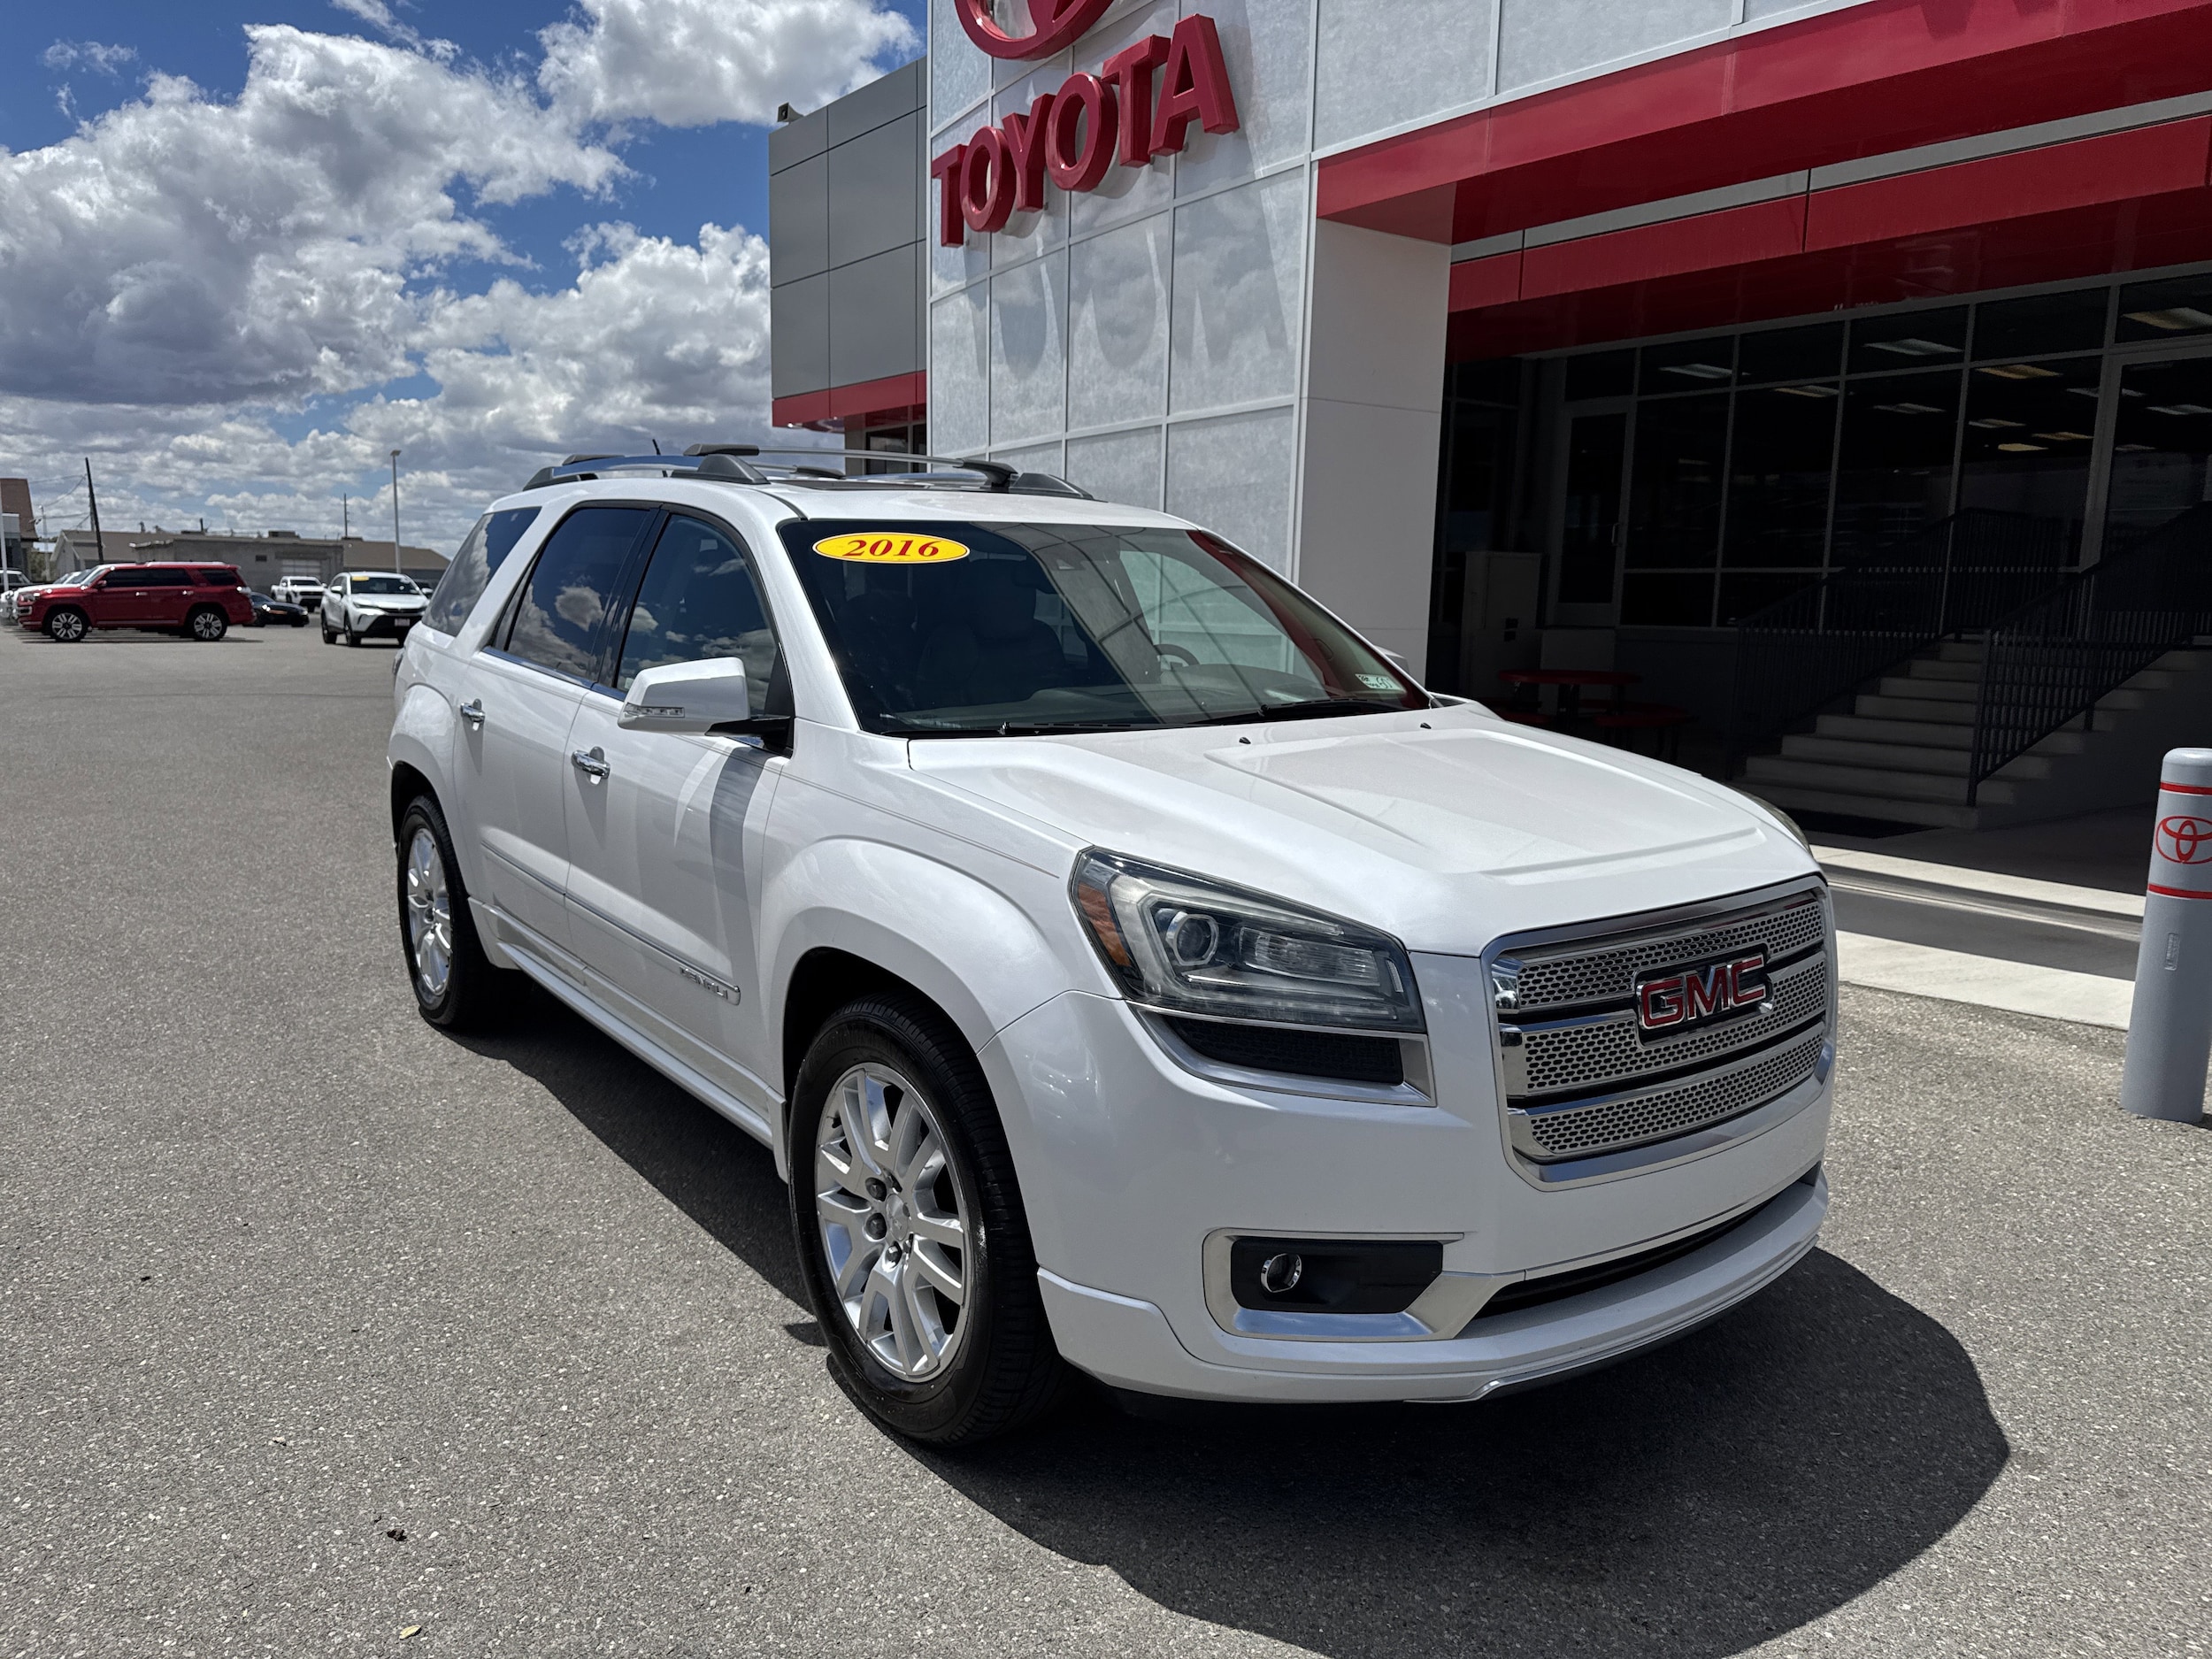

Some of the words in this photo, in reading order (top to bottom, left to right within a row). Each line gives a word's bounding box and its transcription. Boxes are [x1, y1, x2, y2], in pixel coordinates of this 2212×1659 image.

[932, 13, 1240, 248] TOYOTA
[842, 539, 942, 557] 2016
[1637, 954, 1767, 1030] GMC
